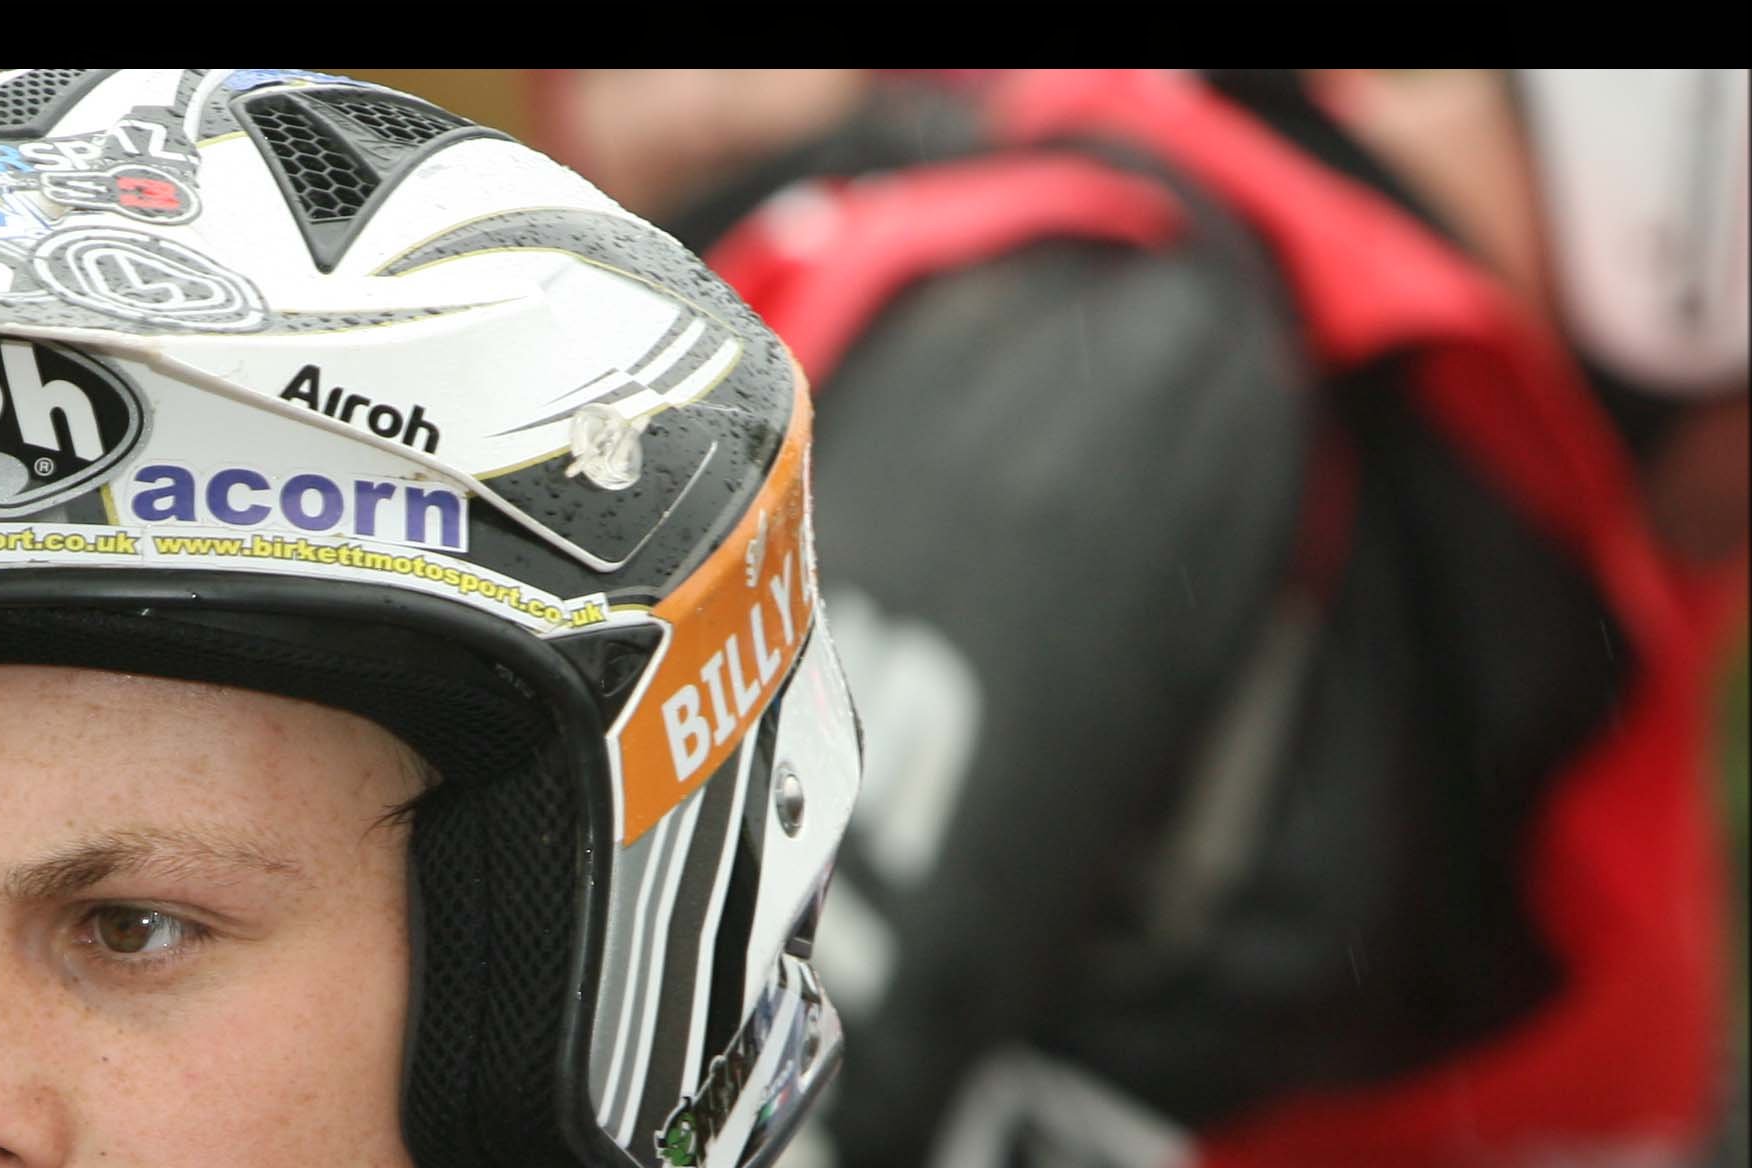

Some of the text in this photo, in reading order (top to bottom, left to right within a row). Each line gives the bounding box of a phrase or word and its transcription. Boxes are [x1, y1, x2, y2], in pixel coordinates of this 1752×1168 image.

[279, 363, 441, 456] Airoh
[131, 463, 462, 549] acorn
[152, 532, 606, 629] www.birkettmotosport.co.uk
[661, 551, 794, 783] BILLY
